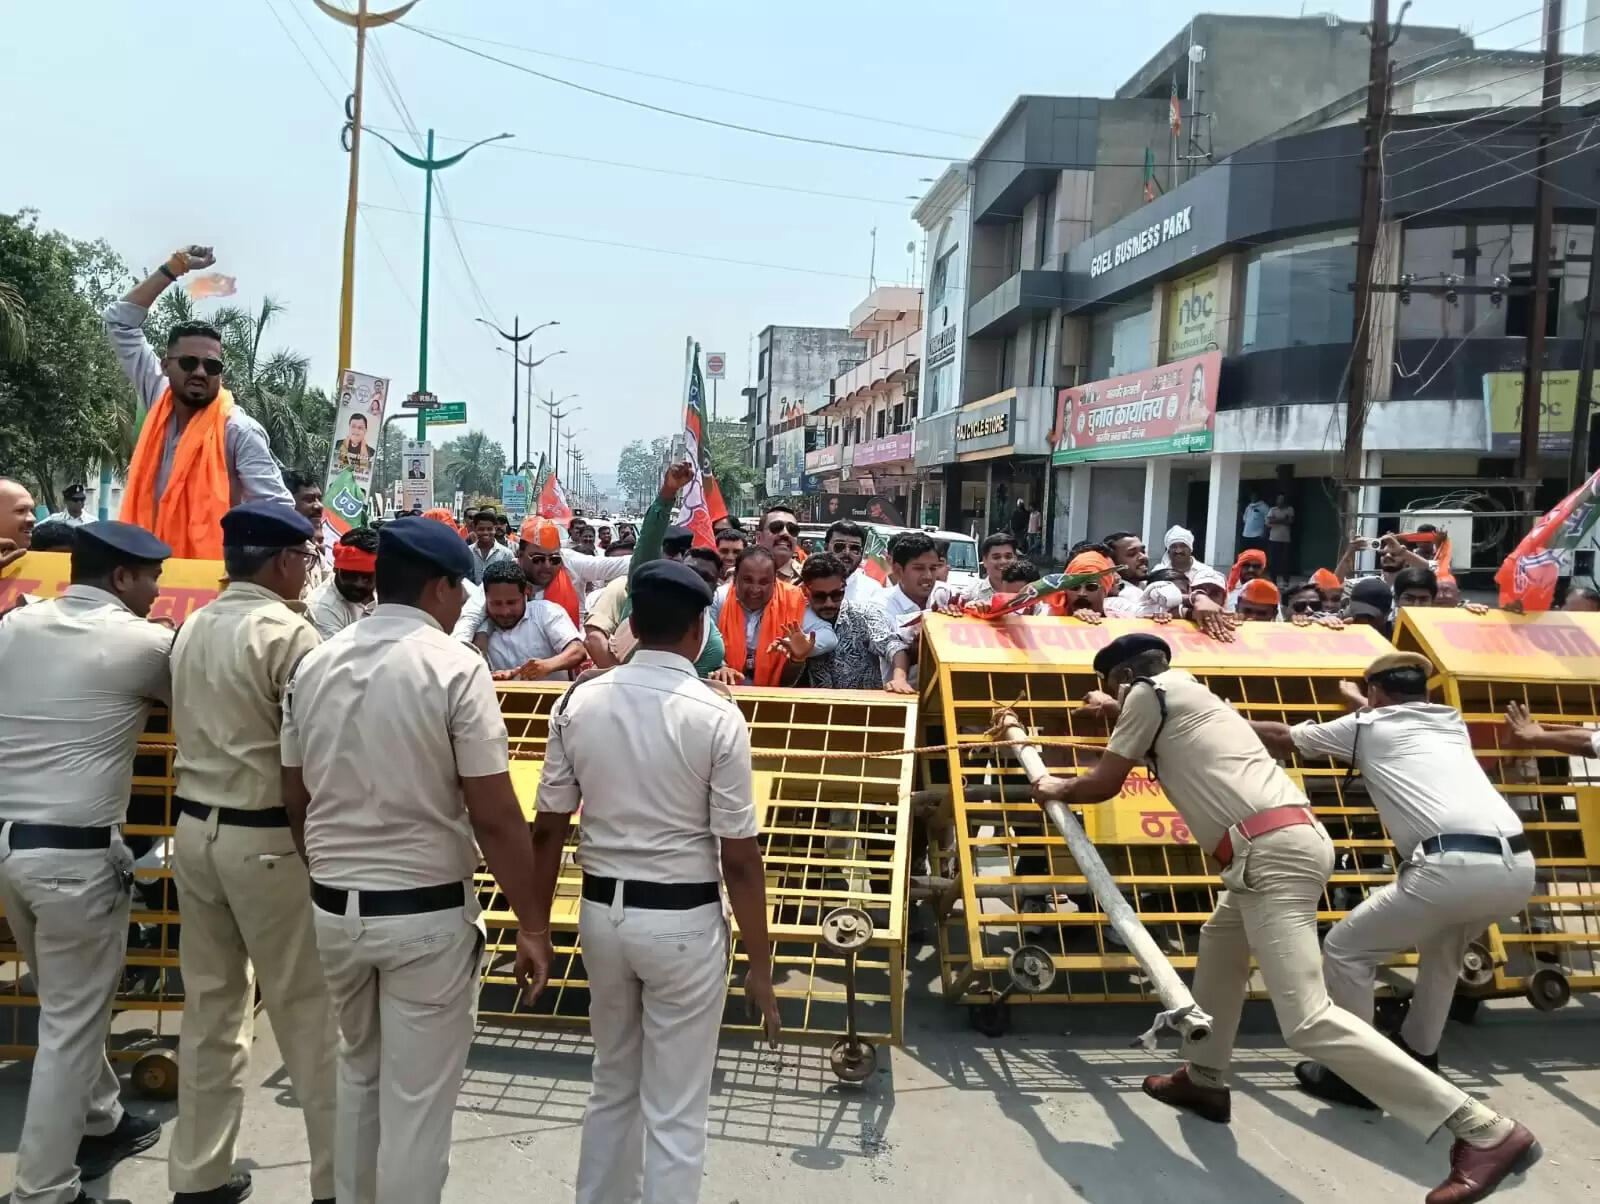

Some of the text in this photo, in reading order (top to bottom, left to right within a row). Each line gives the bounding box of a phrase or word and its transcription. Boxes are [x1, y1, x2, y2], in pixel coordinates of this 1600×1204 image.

[1091, 205, 1193, 279] GOEL BUSINESS PARK
[1179, 282, 1214, 326] nbc
[966, 420, 985, 440] CYCLE
[985, 413, 1005, 435] STORE
[1088, 404, 1114, 436] चुनाव
[1114, 390, 1166, 426] कार्यालय
